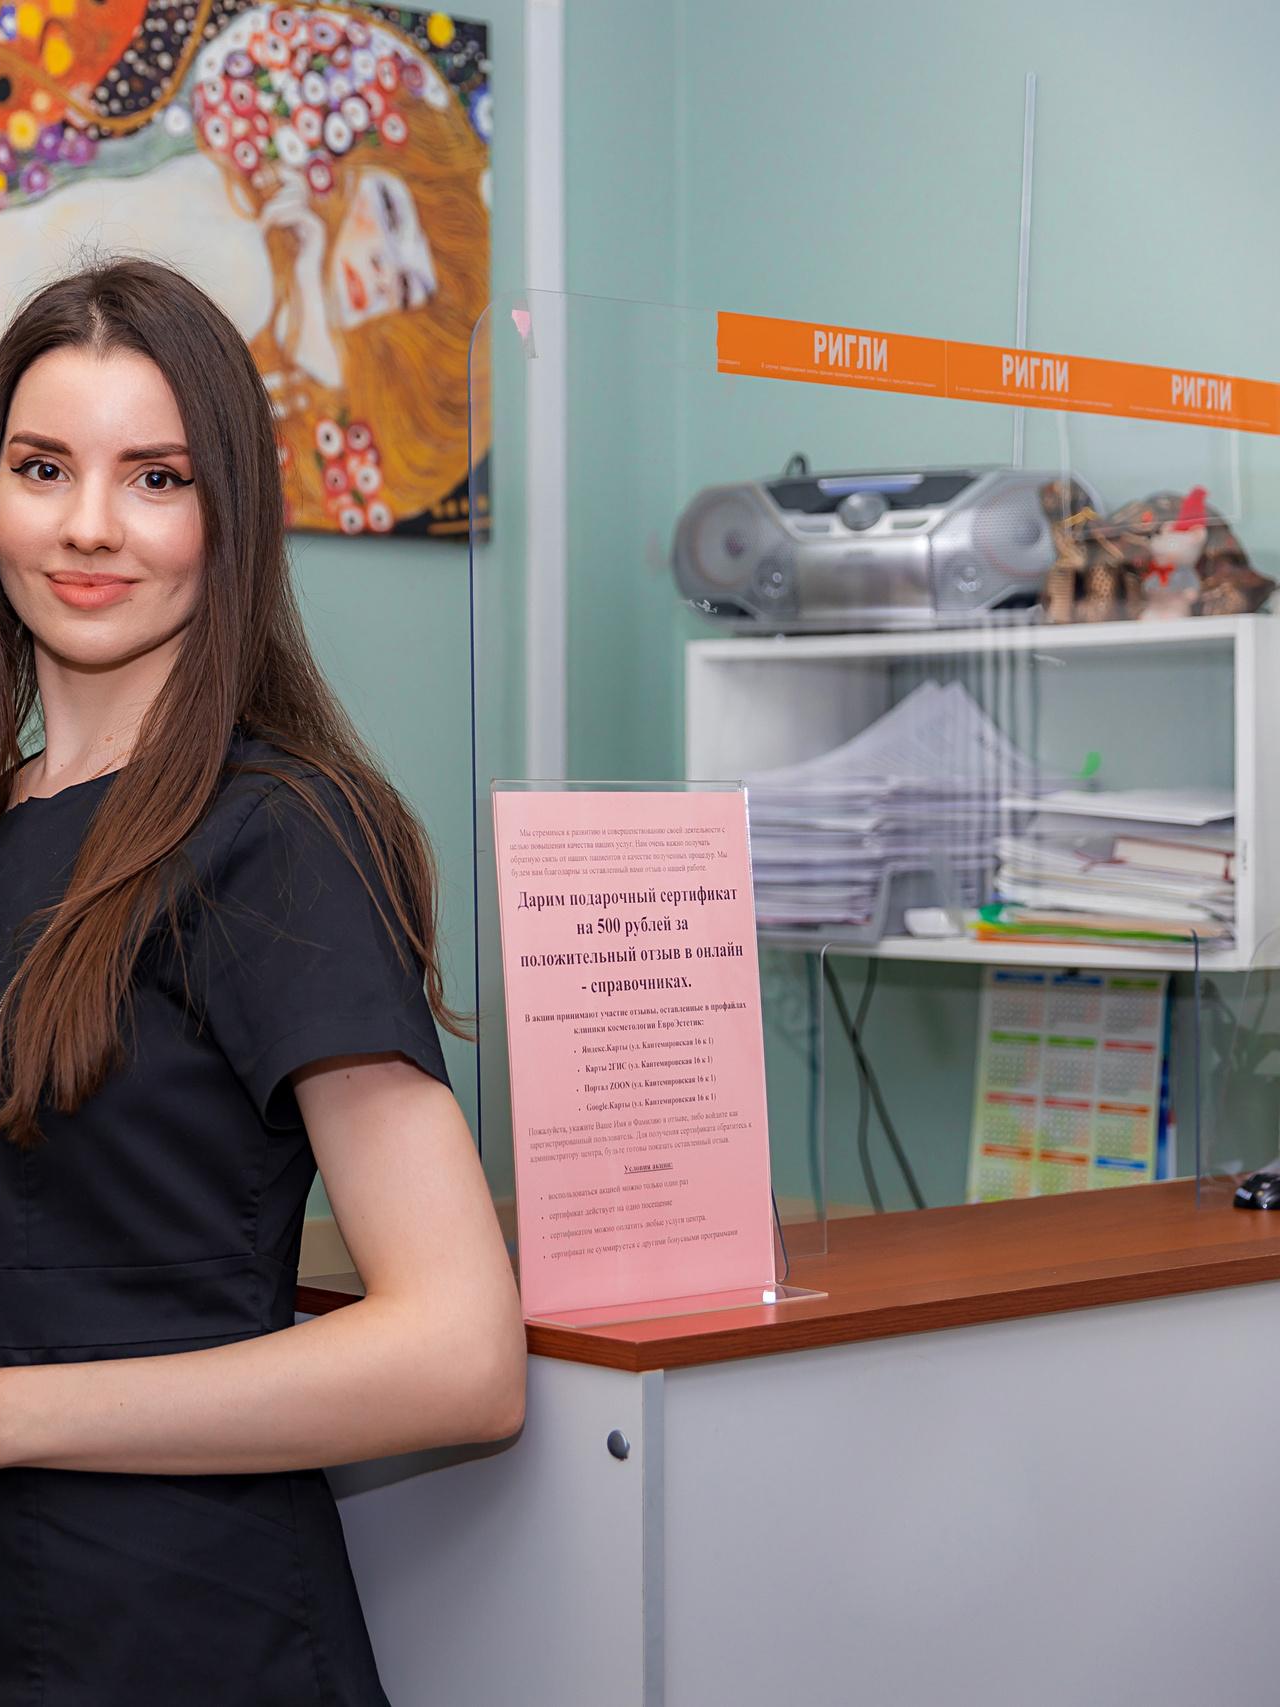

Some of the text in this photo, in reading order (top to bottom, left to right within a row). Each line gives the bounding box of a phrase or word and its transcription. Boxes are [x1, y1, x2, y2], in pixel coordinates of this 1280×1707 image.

[814, 330, 888, 372] РИГЛИ
[1002, 354, 1069, 393] РИГЛИ
[1172, 374, 1232, 412] РИГЛИ
[517, 885, 738, 912] Дарим подарочный сертификат
[576, 916, 689, 937] на 500 рублей за
[520, 942, 744, 968] положительный отзыв в онлайн
[590, 974, 692, 997] справочниках.
[524, 1014, 530, 1022] В
[532, 1013, 555, 1022] акции
[556, 1011, 599, 1022] принимают
[600, 1010, 628, 1020] участие
[629, 1007, 659, 1016] отзывы,
[659, 1004, 704, 1014] оставленные
[710, 1001, 747, 1012] профайлах
[573, 1025, 606, 1035] клиники
[607, 1022, 656, 1032] косметологии
[642, 1039, 694, 1049] Кантемировская
[585, 1064, 607, 1074] Карты
[608, 1061, 626, 1071] 2ГИС
[641, 1058, 693, 1068] Кантемировская
[584, 1084, 608, 1093] Портал
[609, 1081, 630, 1090] ZOON
[644, 1076, 696, 1087] Кантемировская
[644, 1096, 696, 1106] Кантемировская
